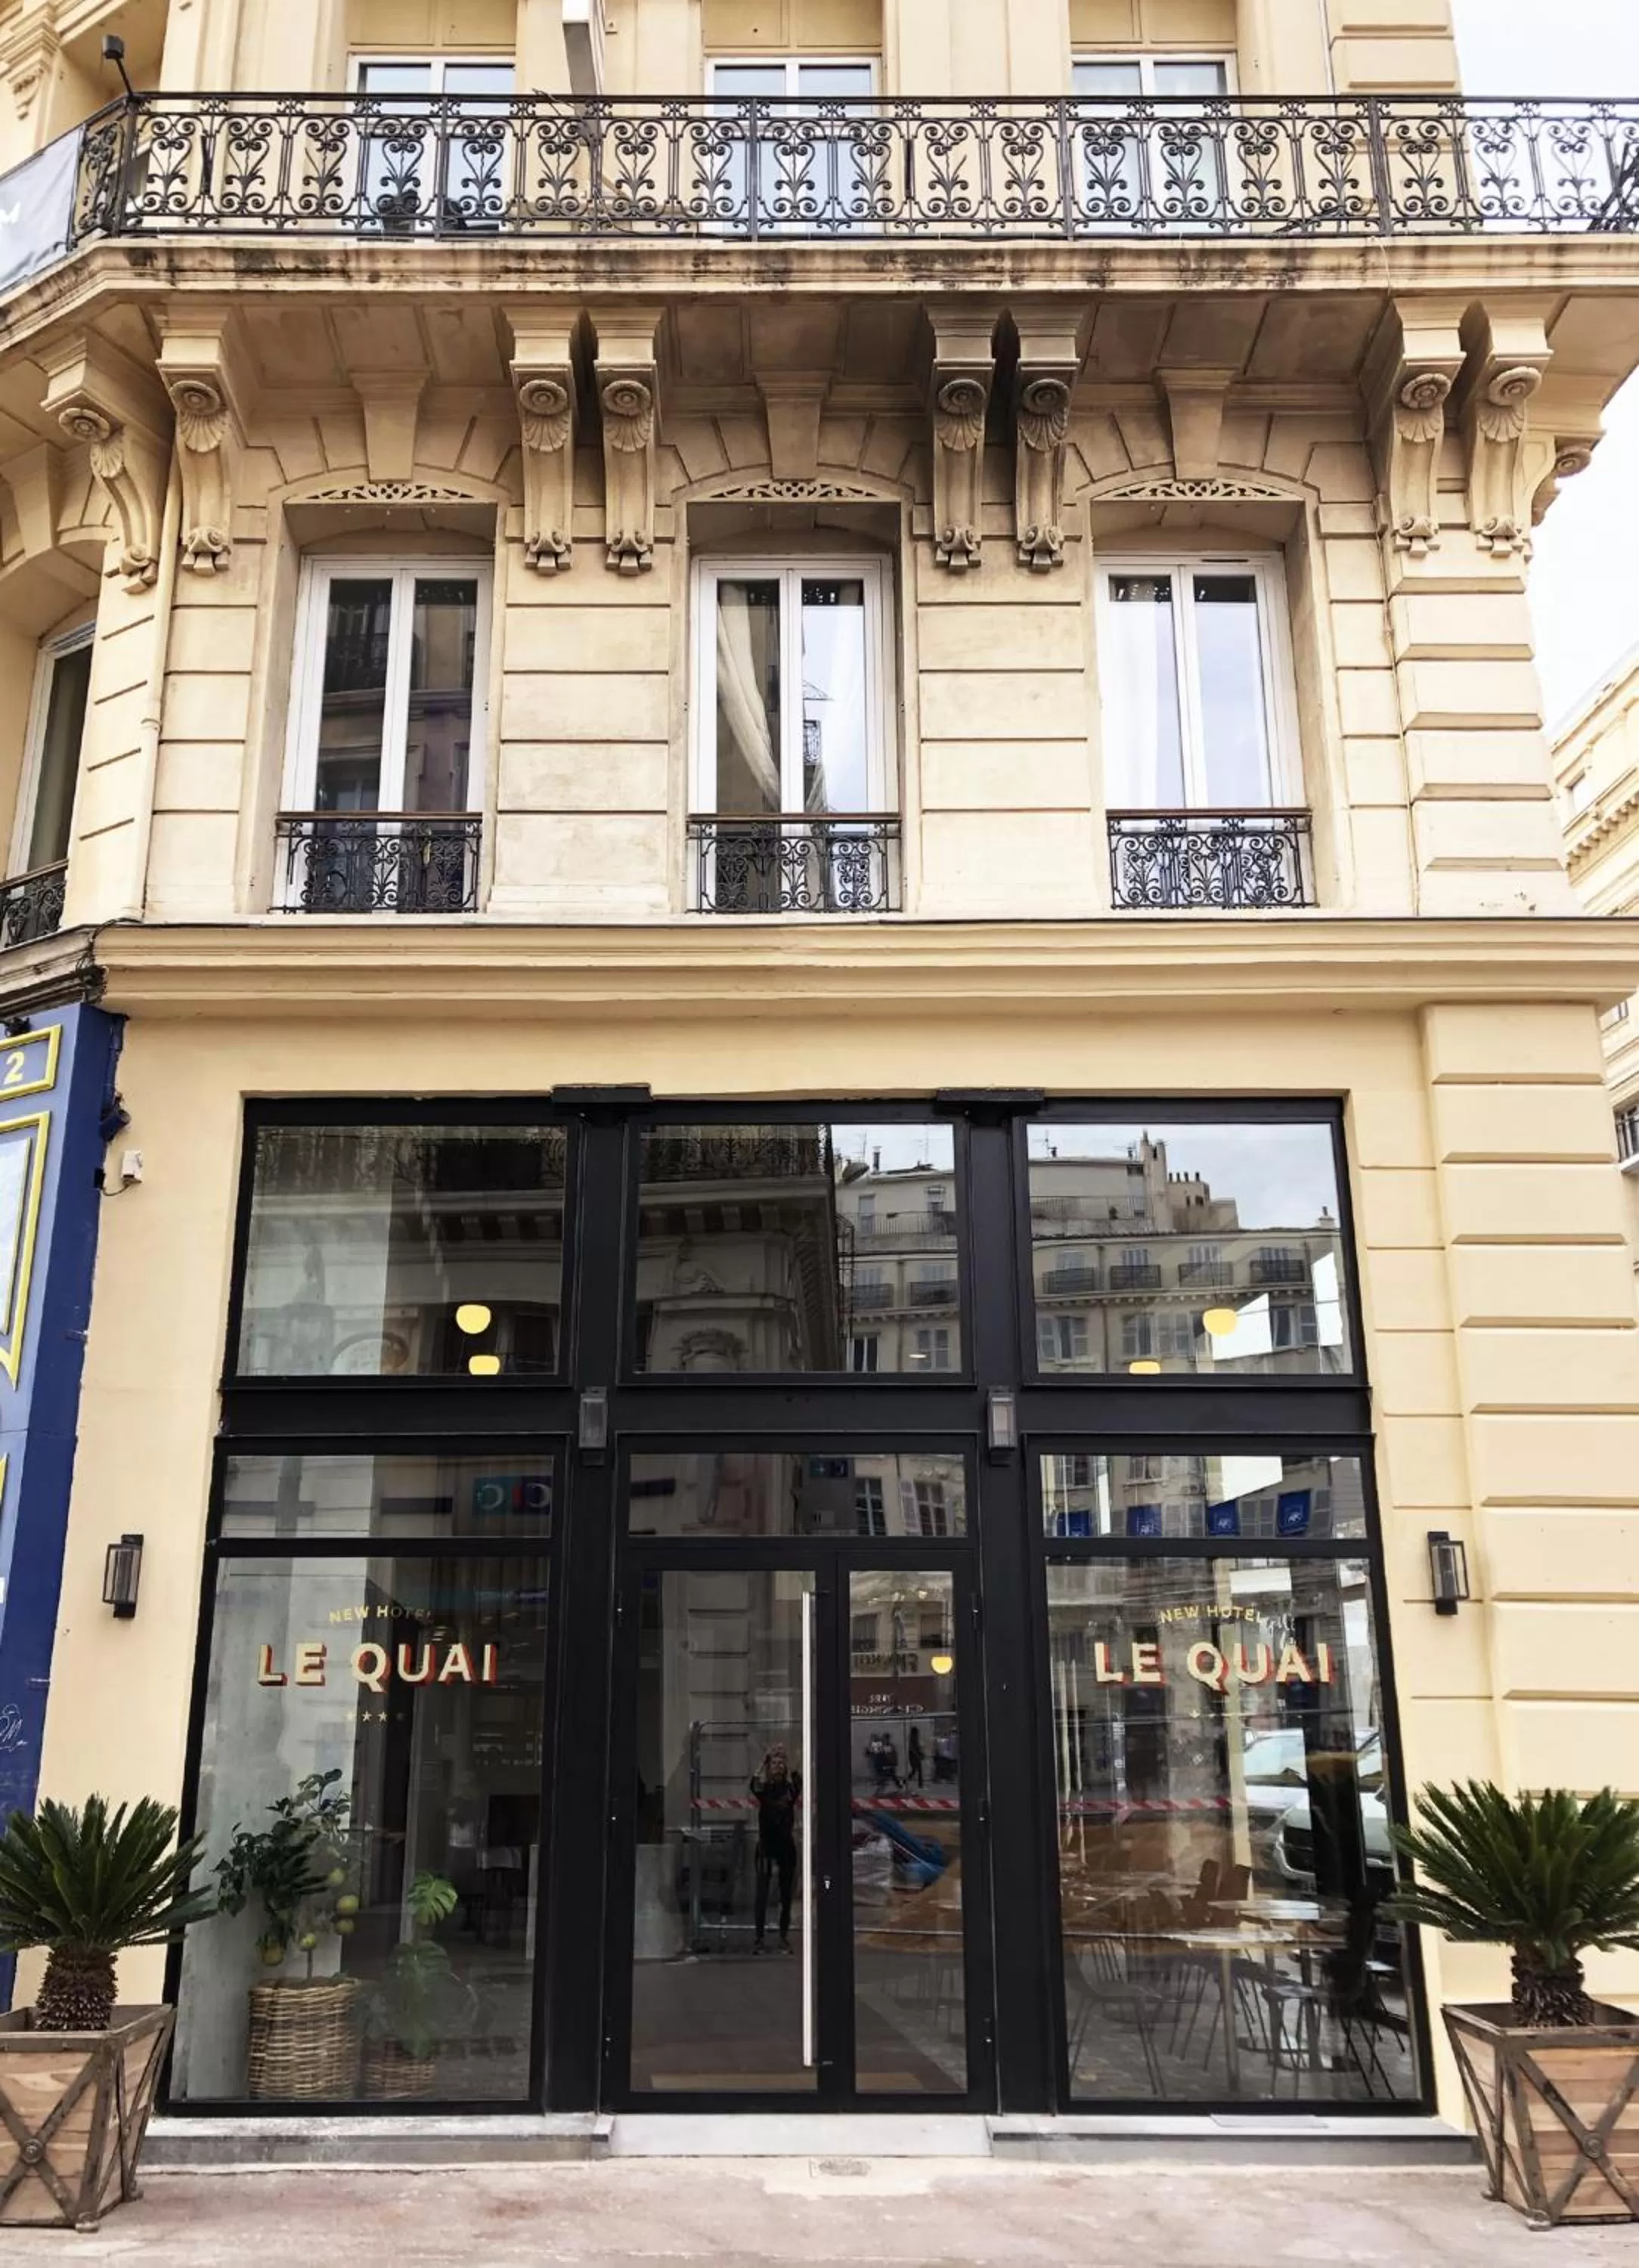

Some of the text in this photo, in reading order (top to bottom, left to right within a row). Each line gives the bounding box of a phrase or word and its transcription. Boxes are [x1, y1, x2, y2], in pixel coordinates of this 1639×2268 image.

[3, 1051, 25, 1085] 2
[328, 1604, 434, 1625] NEW HOTEL
[1160, 1605, 1264, 1624] NEW HOTEL
[257, 1643, 497, 1693] LE QUAI
[1095, 1642, 1334, 1696] LE QUAI
